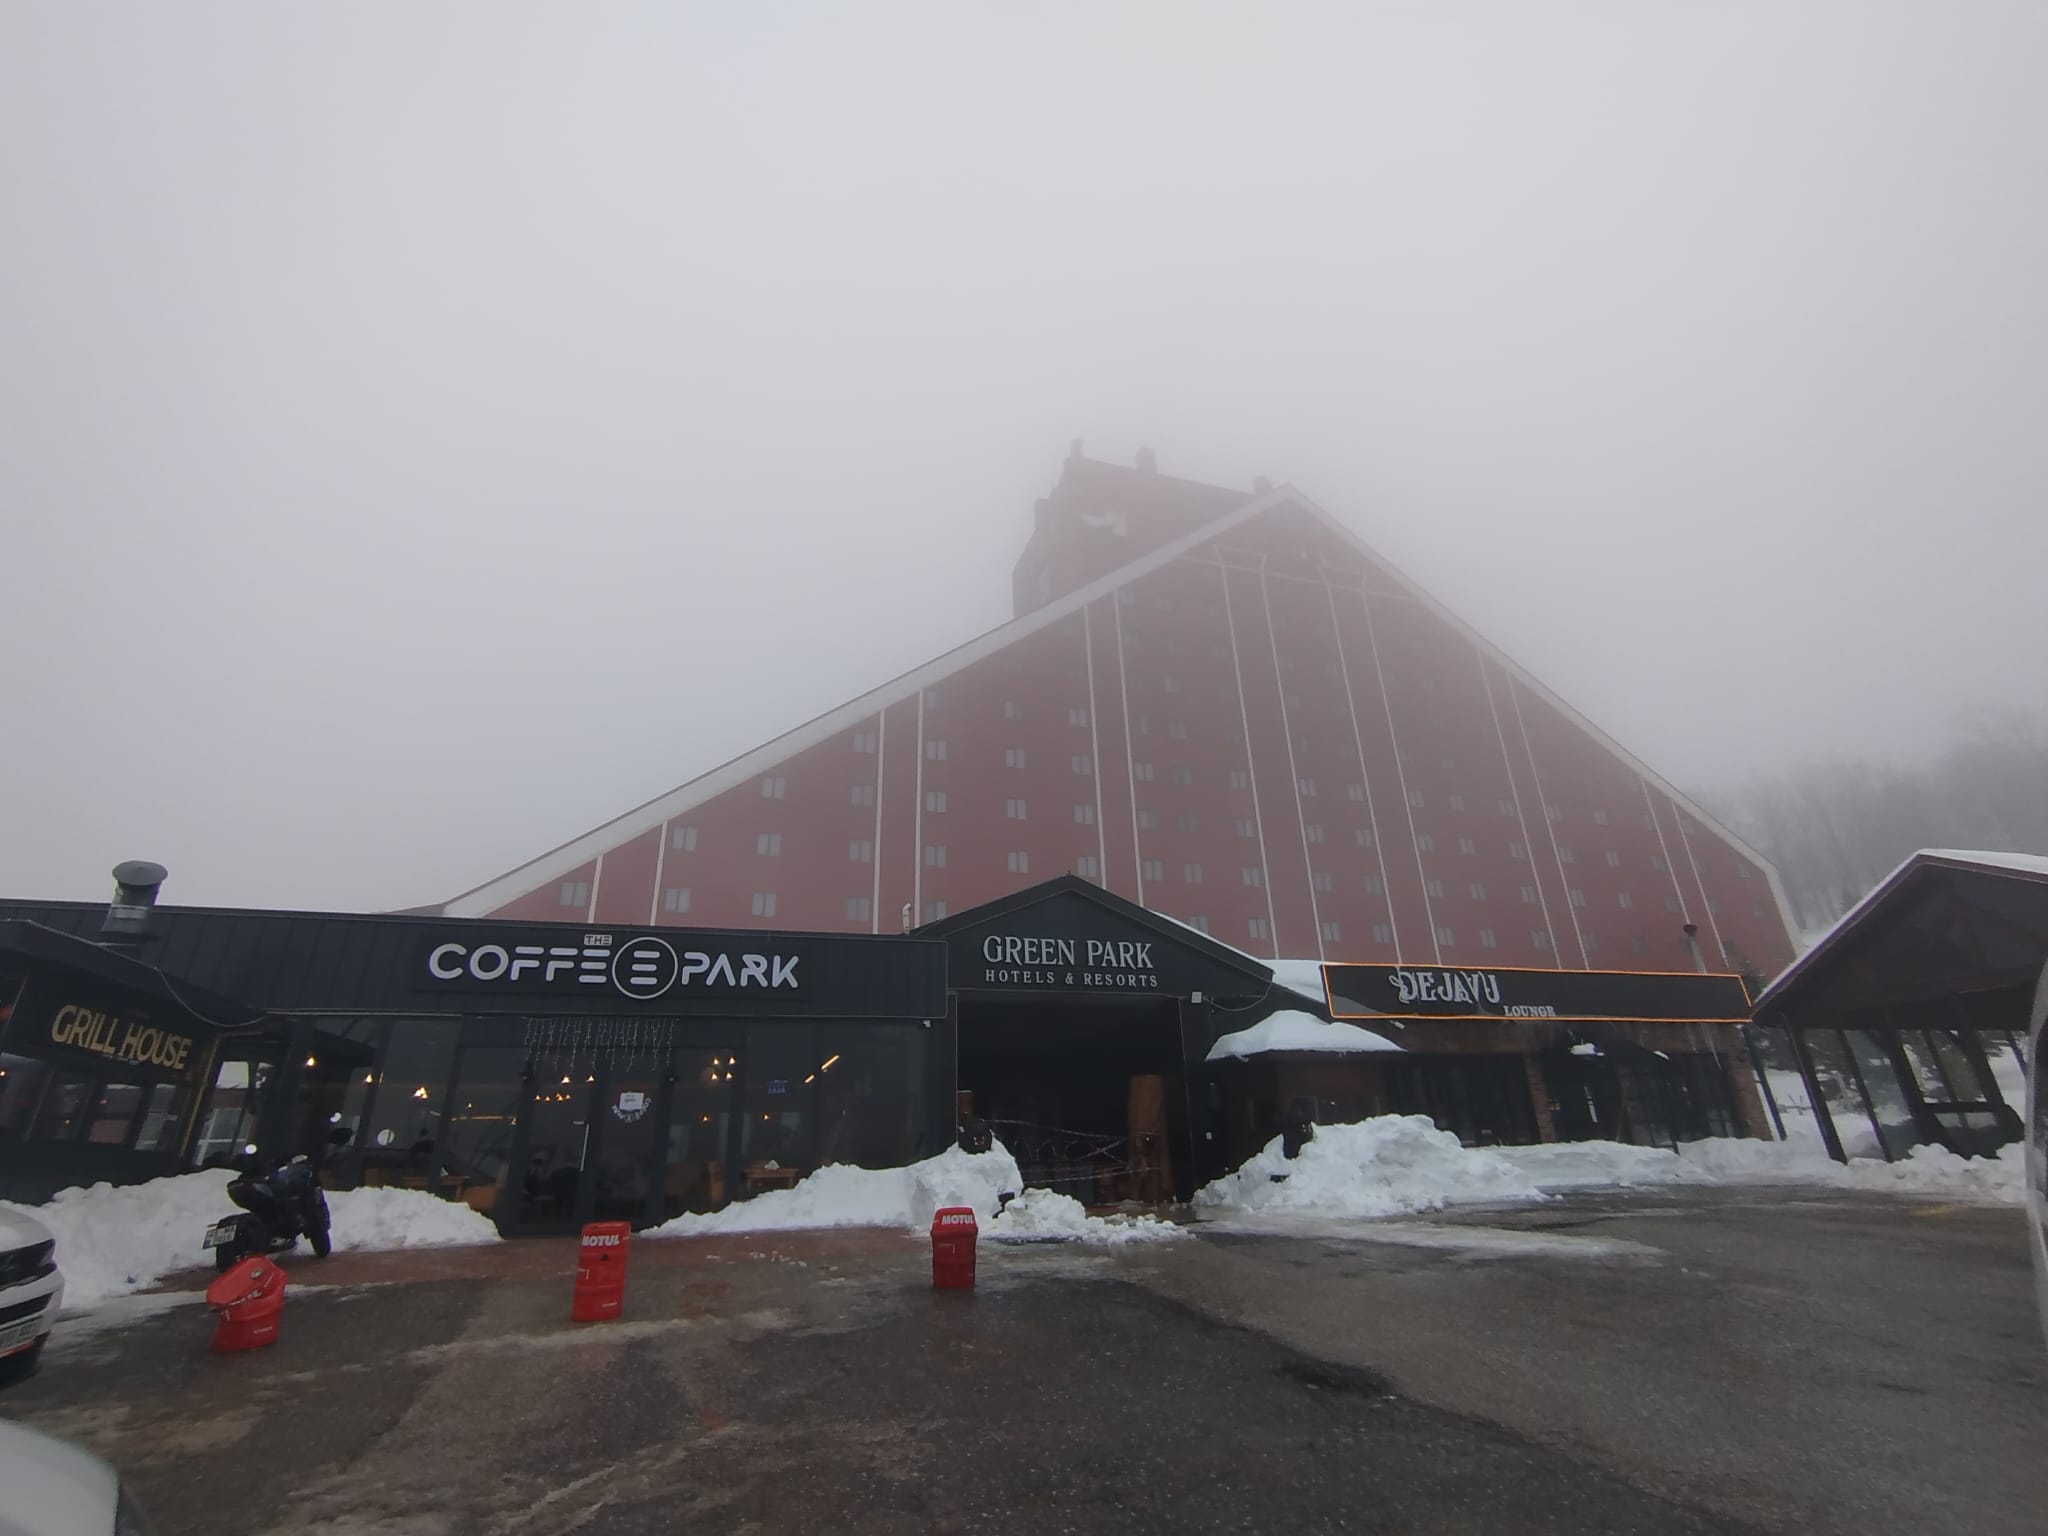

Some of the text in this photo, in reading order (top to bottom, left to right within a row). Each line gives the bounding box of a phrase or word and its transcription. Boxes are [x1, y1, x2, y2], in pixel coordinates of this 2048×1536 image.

[584, 934, 612, 946] THE
[983, 935, 1154, 969] GREEN PARK
[681, 951, 800, 988] PARK
[985, 969, 1158, 987] HOTELS & RESORTS
[1503, 1005, 1557, 1017] LOUNGE
[51, 1004, 192, 1071] GRILL HOUSE
[942, 1214, 974, 1225] MOTUL
[581, 1234, 620, 1247] MOTUL
